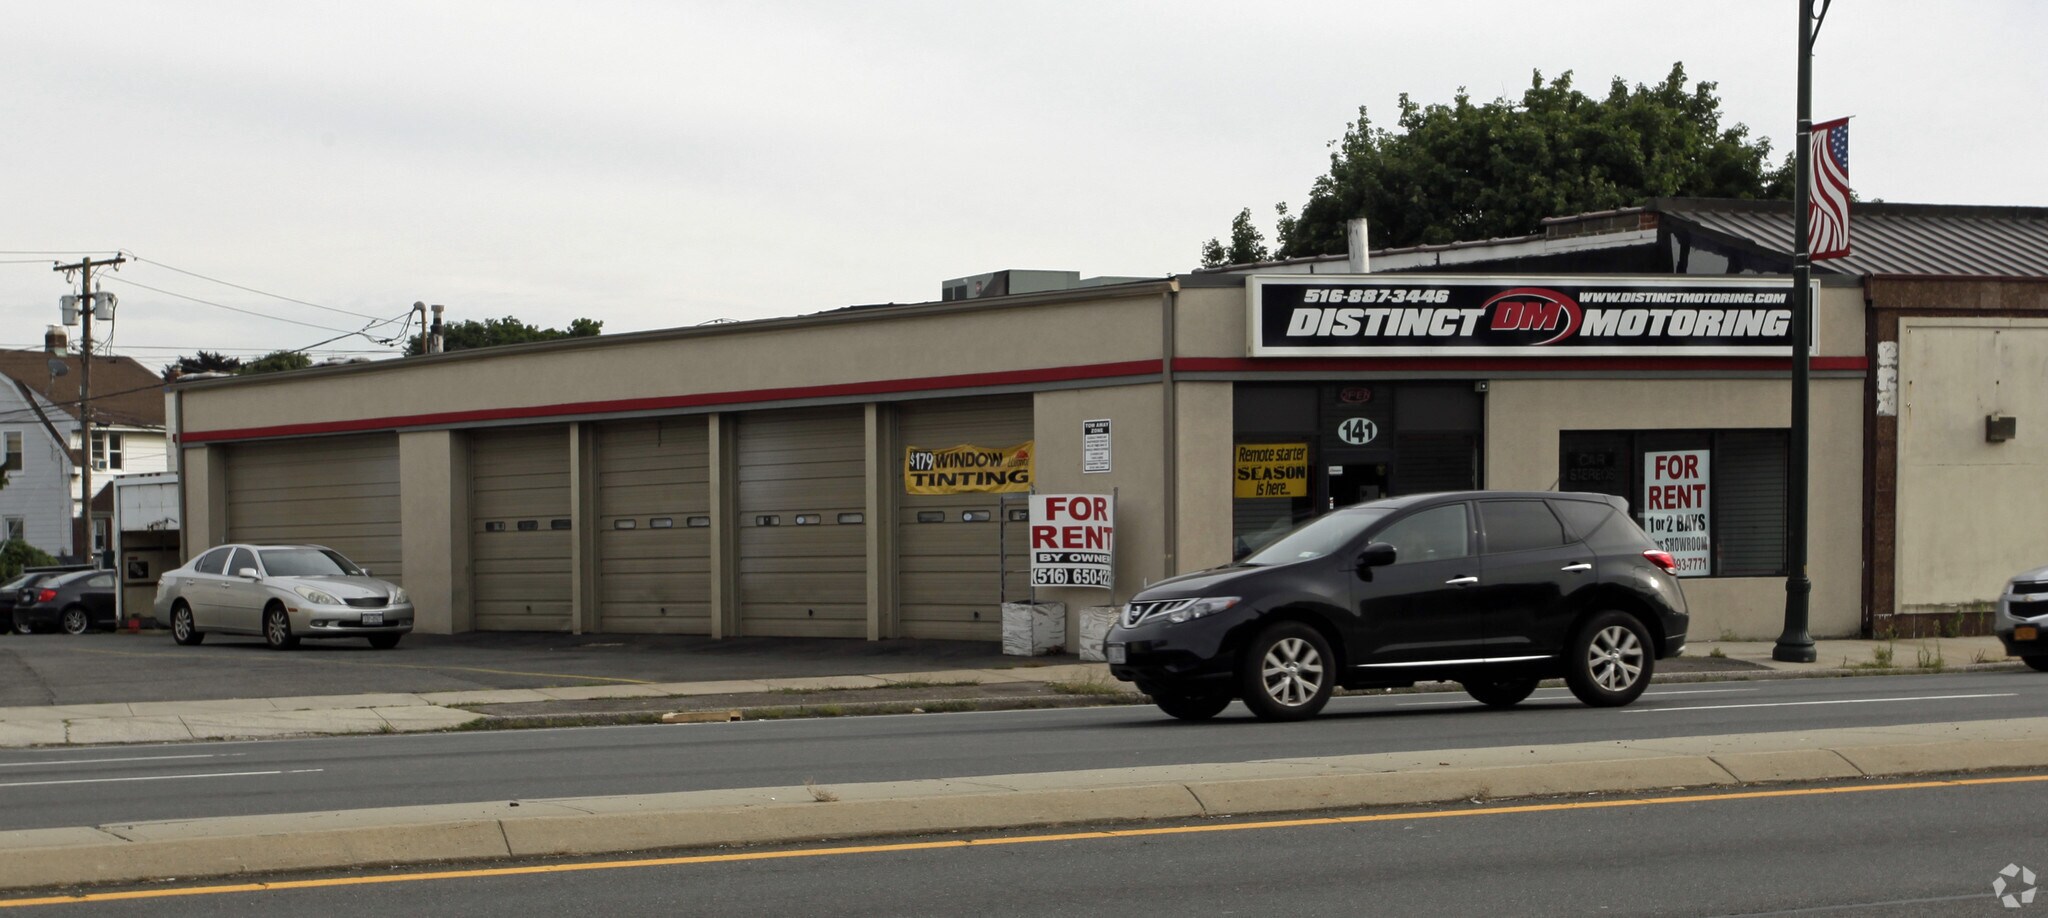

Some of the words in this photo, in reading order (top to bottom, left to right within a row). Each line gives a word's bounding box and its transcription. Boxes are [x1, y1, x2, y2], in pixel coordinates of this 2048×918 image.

[1303, 289, 1450, 303] 516-887-3446
[1579, 292, 1786, 304] WWW.DISTINCTMOTORING.COM
[1286, 308, 1486, 337] DISTINCT
[1490, 301, 1562, 331] DM
[1579, 308, 1792, 337] MOTORING
[1342, 419, 1373, 443] 141
[910, 451, 934, 471] $179
[935, 452, 1003, 468] WINDOW
[1239, 446, 1275, 462] Remote
[1275, 446, 1306, 462] starter
[1237, 466, 1306, 480] SEASON
[1655, 454, 1699, 480] FOR
[910, 470, 1029, 487] TINTING
[1256, 480, 1264, 496] is
[1649, 484, 1706, 510] RENT
[1046, 497, 1108, 522] FOR
[1649, 515, 1654, 533] 1
[1655, 519, 1665, 531] or
[1666, 515, 1673, 533] 2
[1677, 513, 1706, 532] BAYS
[1032, 525, 1113, 551] RENT
[1665, 537, 1708, 552] SHOWROOM
[1039, 553, 1063, 562] BY
[1674, 556, 1707, 571] 93-7771
[1033, 568, 1068, 585] (516)
